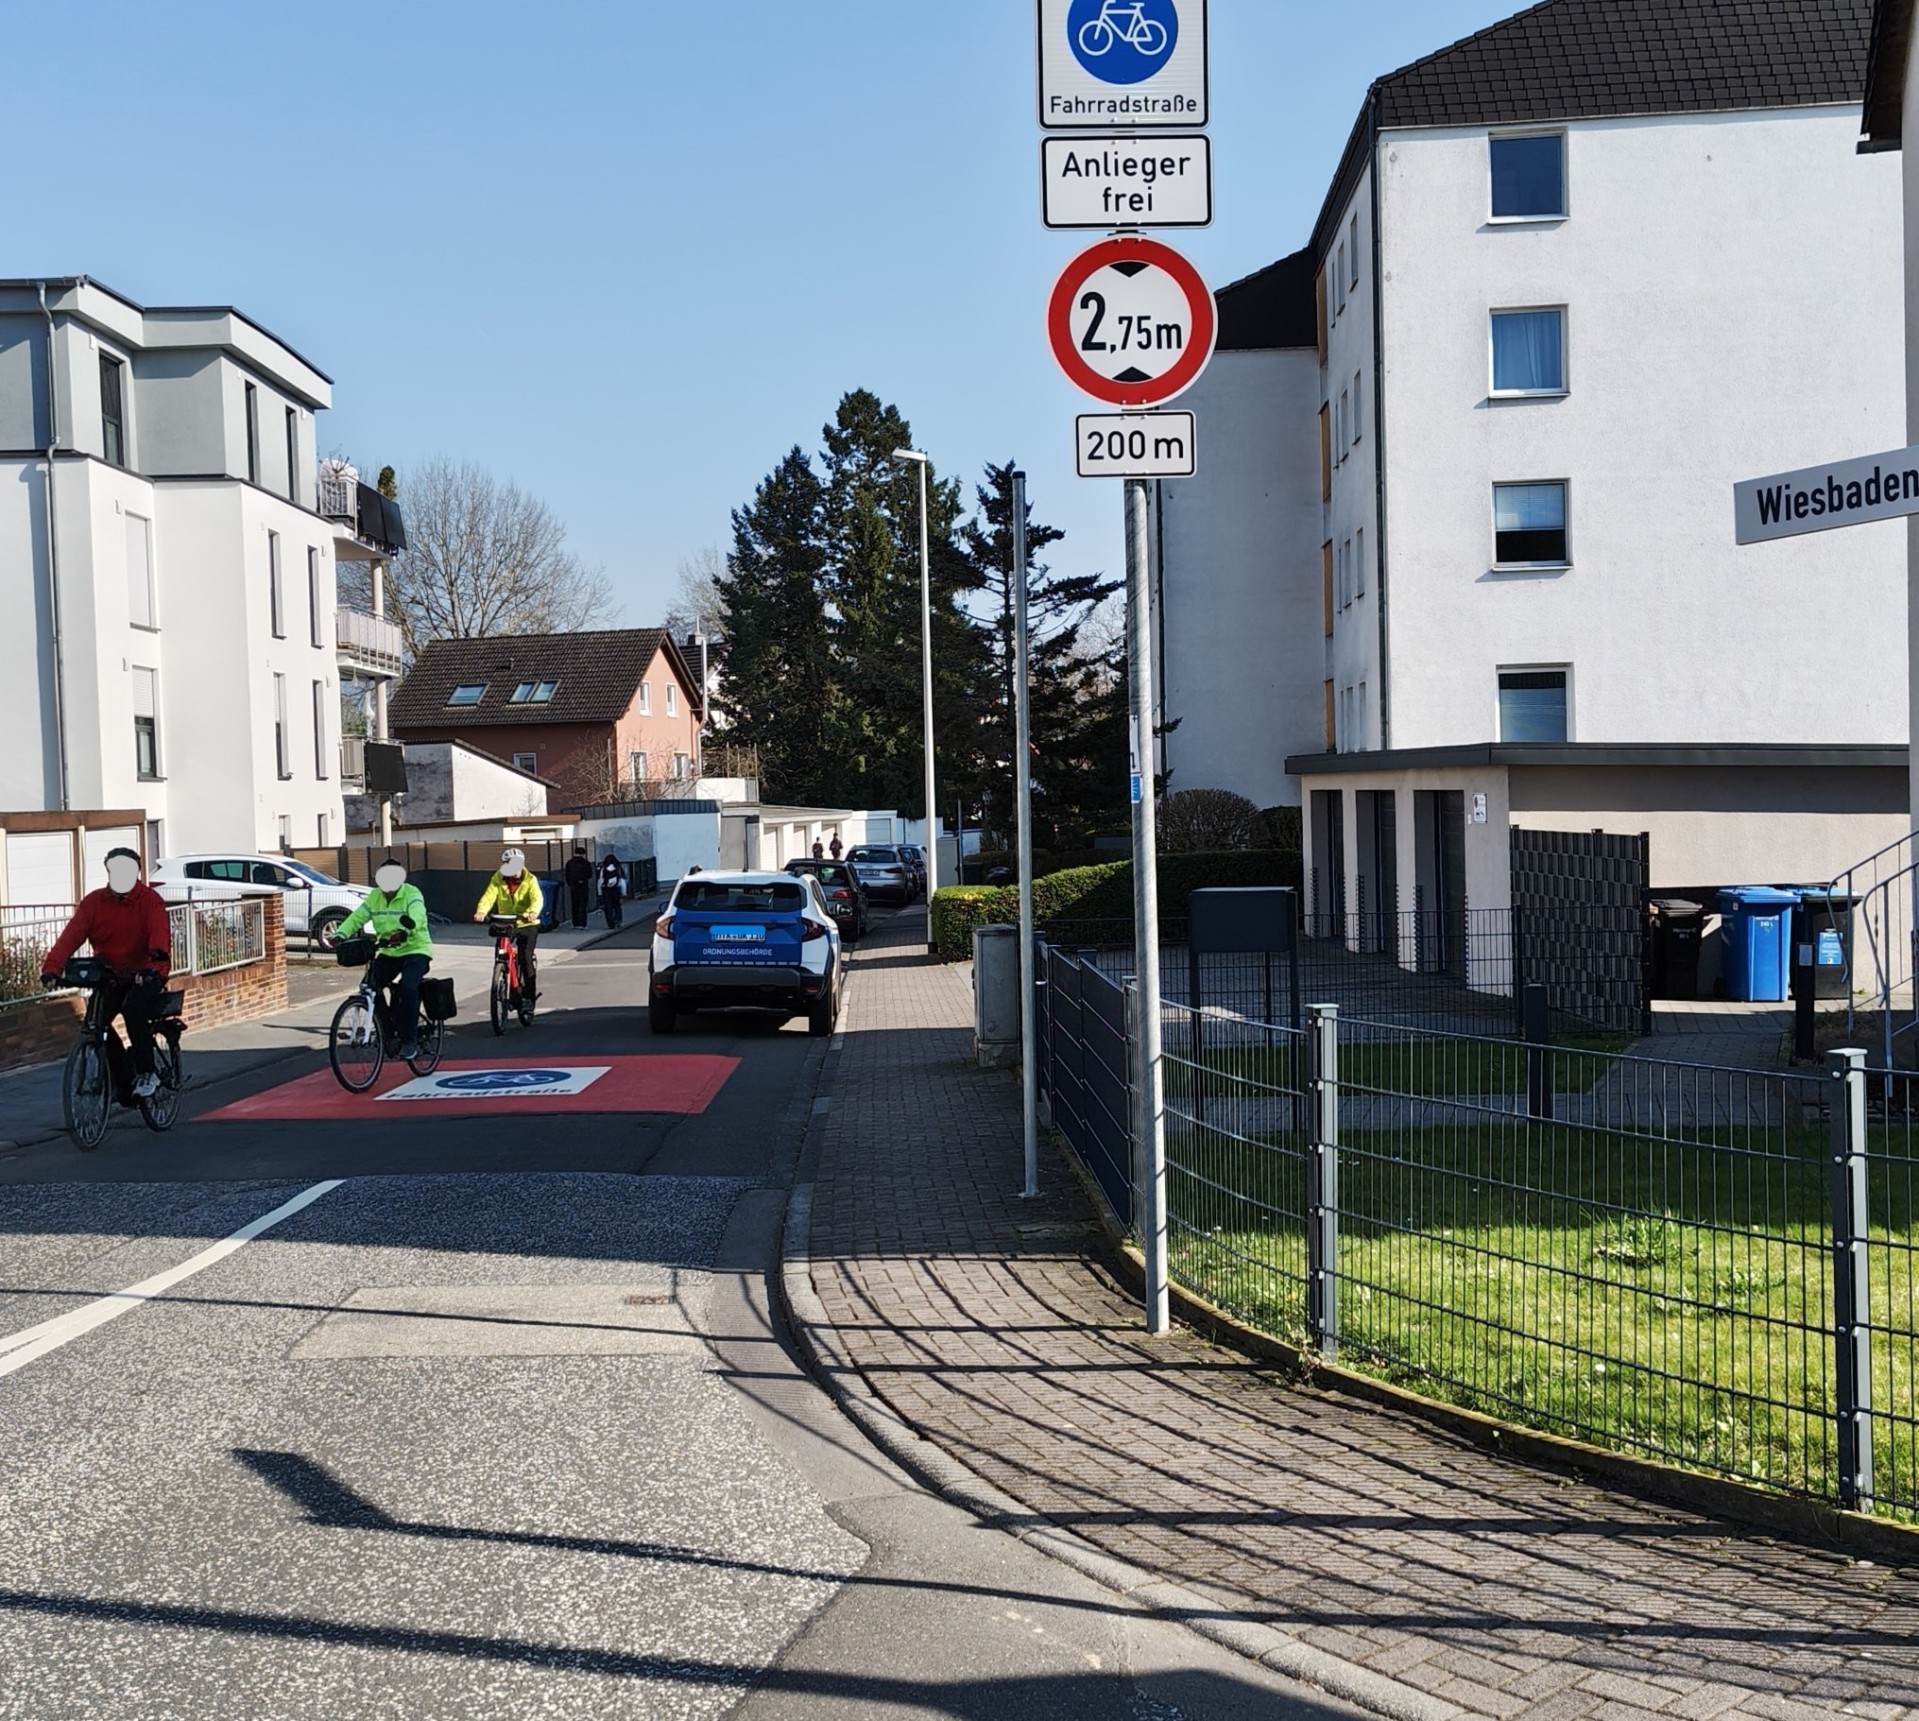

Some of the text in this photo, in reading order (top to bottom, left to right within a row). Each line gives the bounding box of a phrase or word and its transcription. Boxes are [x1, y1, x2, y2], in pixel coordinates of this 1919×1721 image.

[1050, 94, 1197, 114] Fahrradstraße
[1061, 151, 1191, 184] Anlieger
[1102, 186, 1153, 212] frei
[1756, 466, 1919, 526] Wiesbaden
[702, 947, 773, 957] ORDNUNGSBEHÖRDE
[386, 1087, 573, 1099] Fahrradstraße
